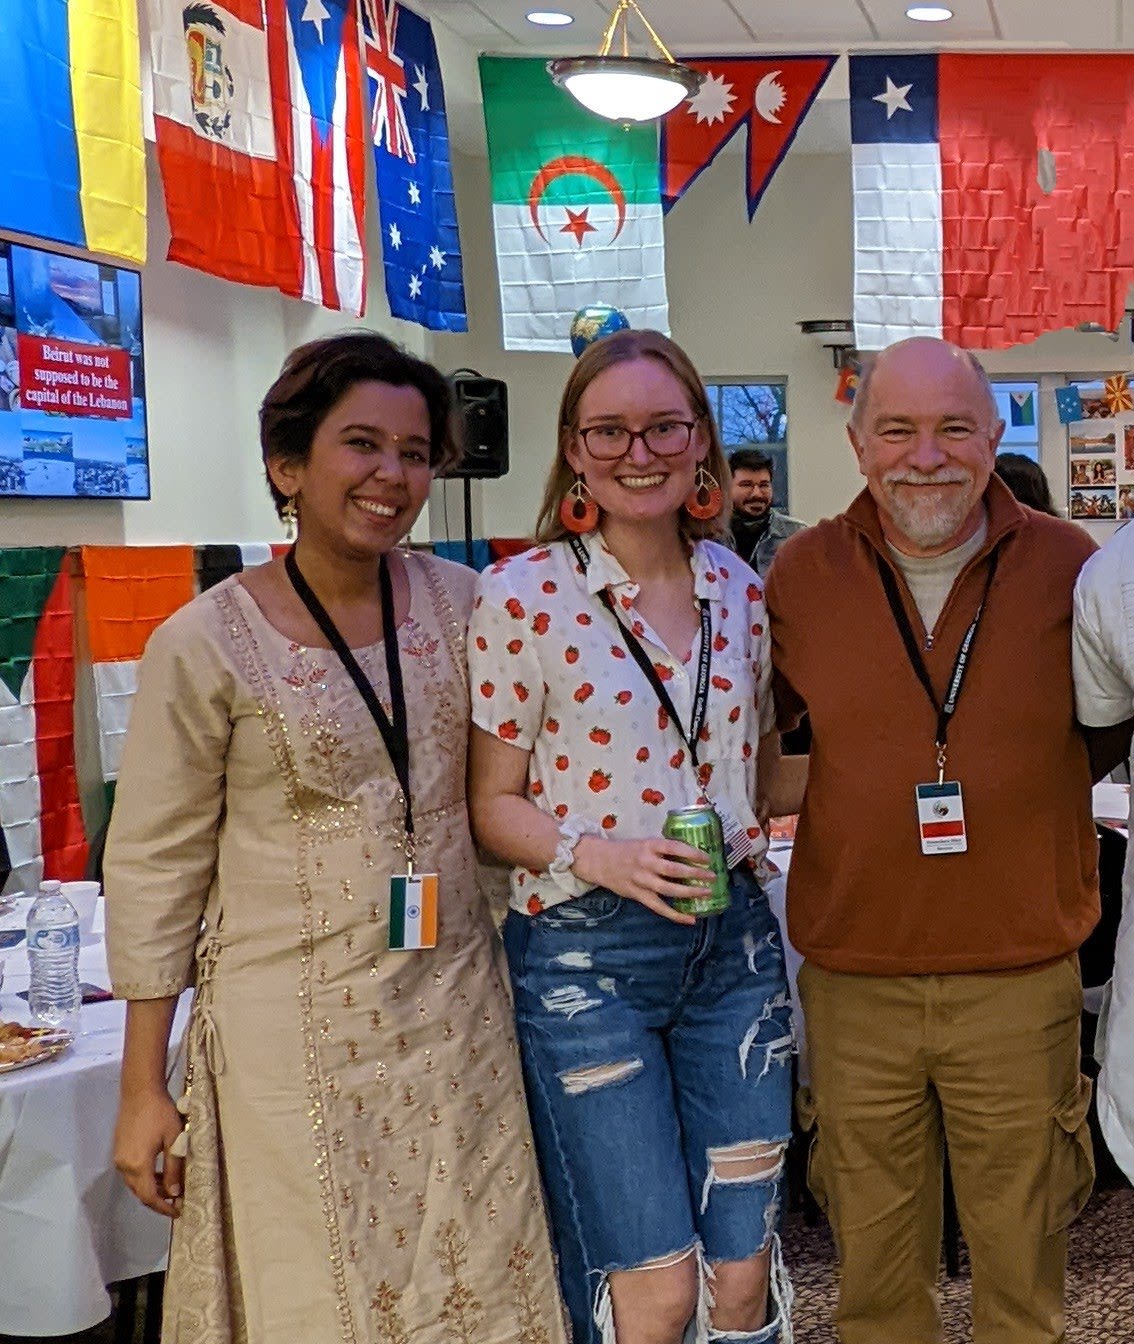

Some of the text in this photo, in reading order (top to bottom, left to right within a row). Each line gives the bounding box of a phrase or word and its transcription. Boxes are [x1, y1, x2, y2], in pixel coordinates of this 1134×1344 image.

[43, 345, 109, 369] Beirut was not
[34, 369, 119, 390] supposed to be the
[25, 388, 128, 411] capital of the Lebanon
[949, 664, 963, 703] UNIVERSITY
[959, 654, 966, 663] OF
